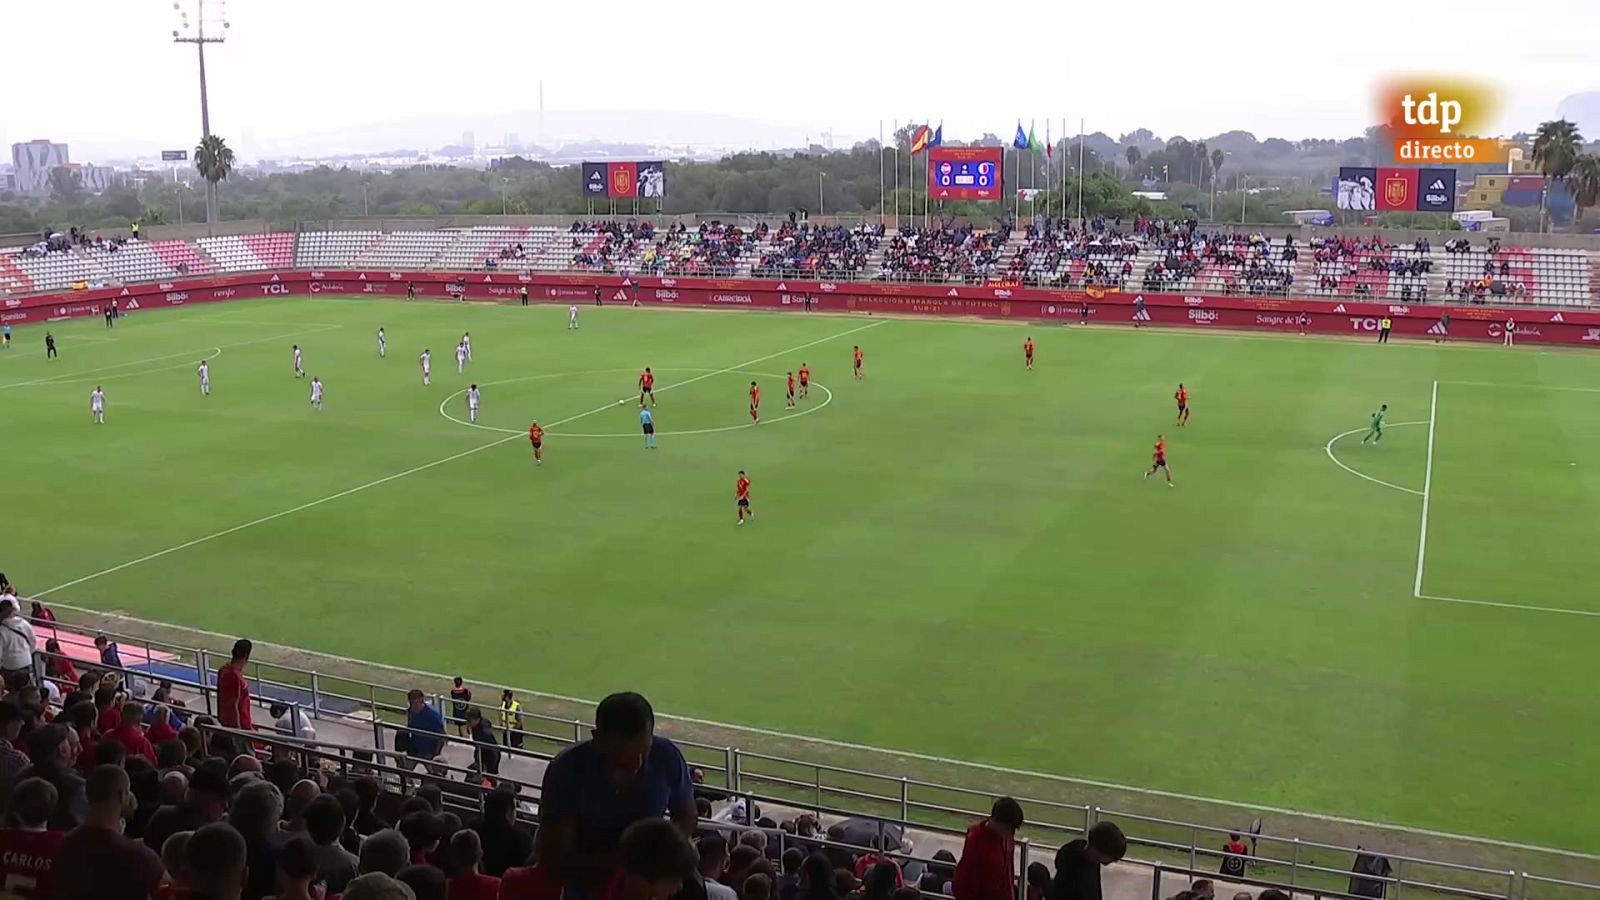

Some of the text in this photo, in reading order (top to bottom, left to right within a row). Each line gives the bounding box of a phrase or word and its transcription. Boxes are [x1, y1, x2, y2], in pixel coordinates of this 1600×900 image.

[942, 175, 950, 186] 0
[979, 175, 988, 186] 0
[261, 284, 289, 294] TCL
[1256, 314, 1284, 325] Sangre
[1285, 316, 1295, 324] de
[3, 851, 53, 873] CARLOS
